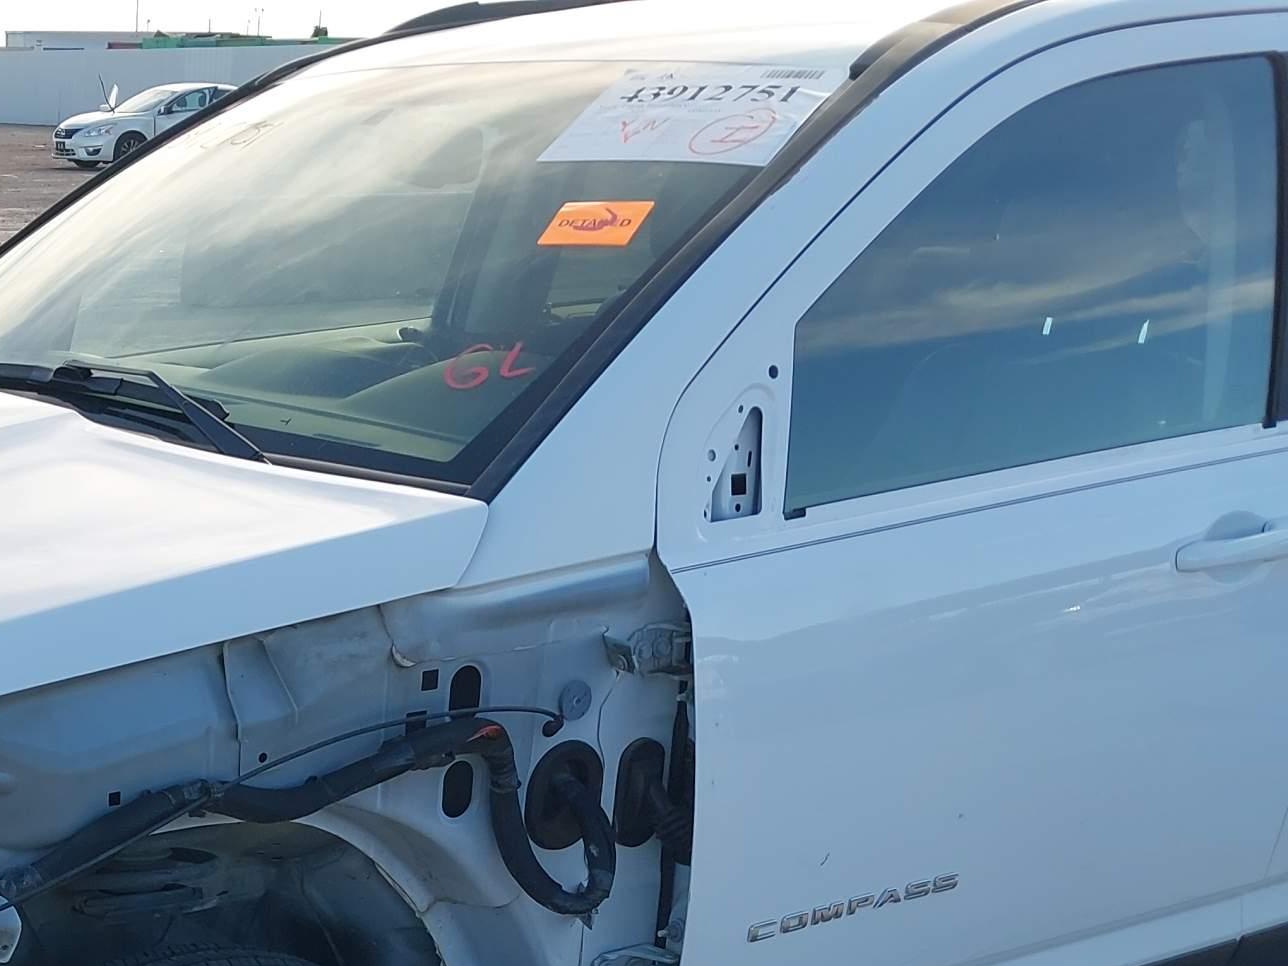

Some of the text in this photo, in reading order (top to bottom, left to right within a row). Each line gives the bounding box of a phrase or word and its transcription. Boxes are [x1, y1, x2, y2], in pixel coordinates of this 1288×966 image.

[620, 85, 800, 103] 43912751
[558, 218, 632, 229] DETAD
[747, 872, 960, 943] COMPASS
